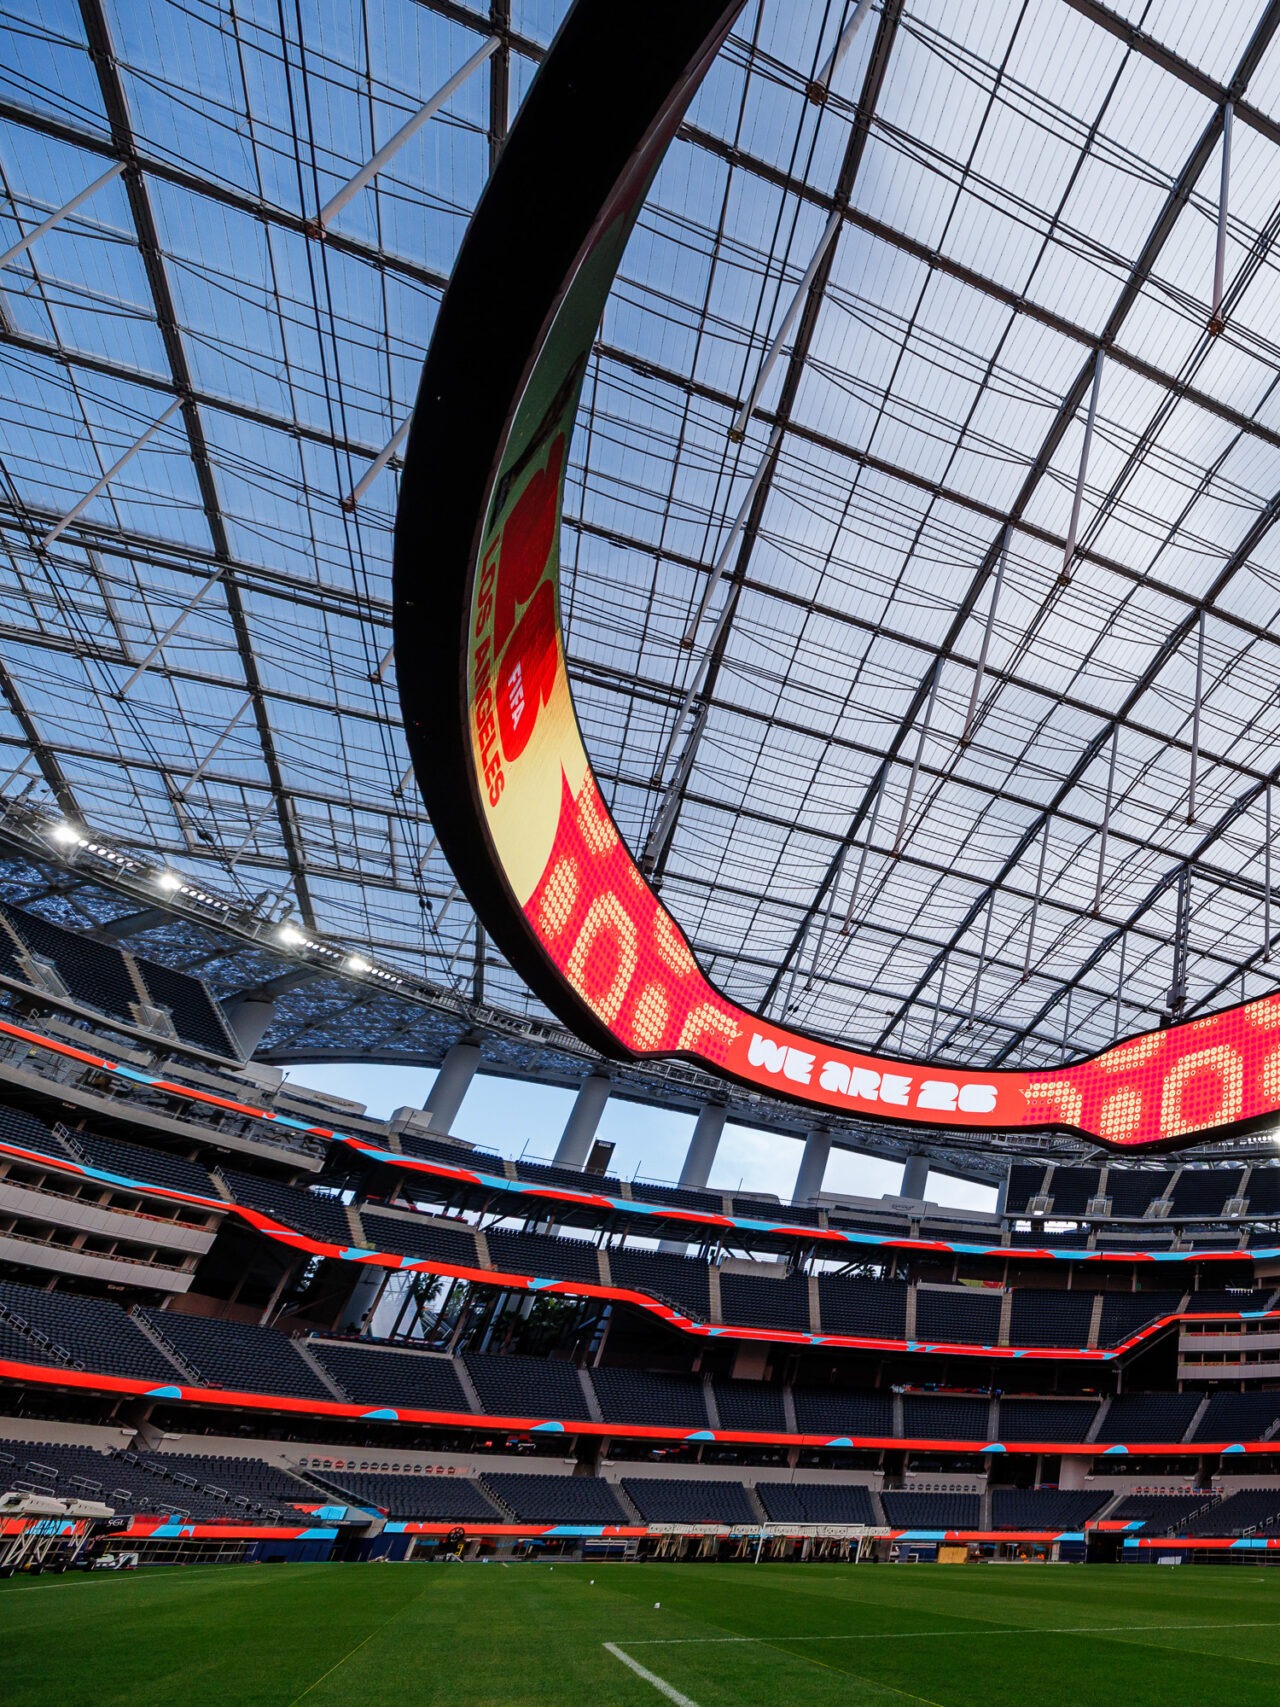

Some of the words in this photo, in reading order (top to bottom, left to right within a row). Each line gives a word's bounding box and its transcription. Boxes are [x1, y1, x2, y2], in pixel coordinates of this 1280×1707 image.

[475, 531, 500, 639] LOS
[474, 635, 505, 808] ANGELES
[508, 660, 525, 731] FIFA
[747, 1033, 816, 1085] WE
[916, 1080, 998, 1113] 26
